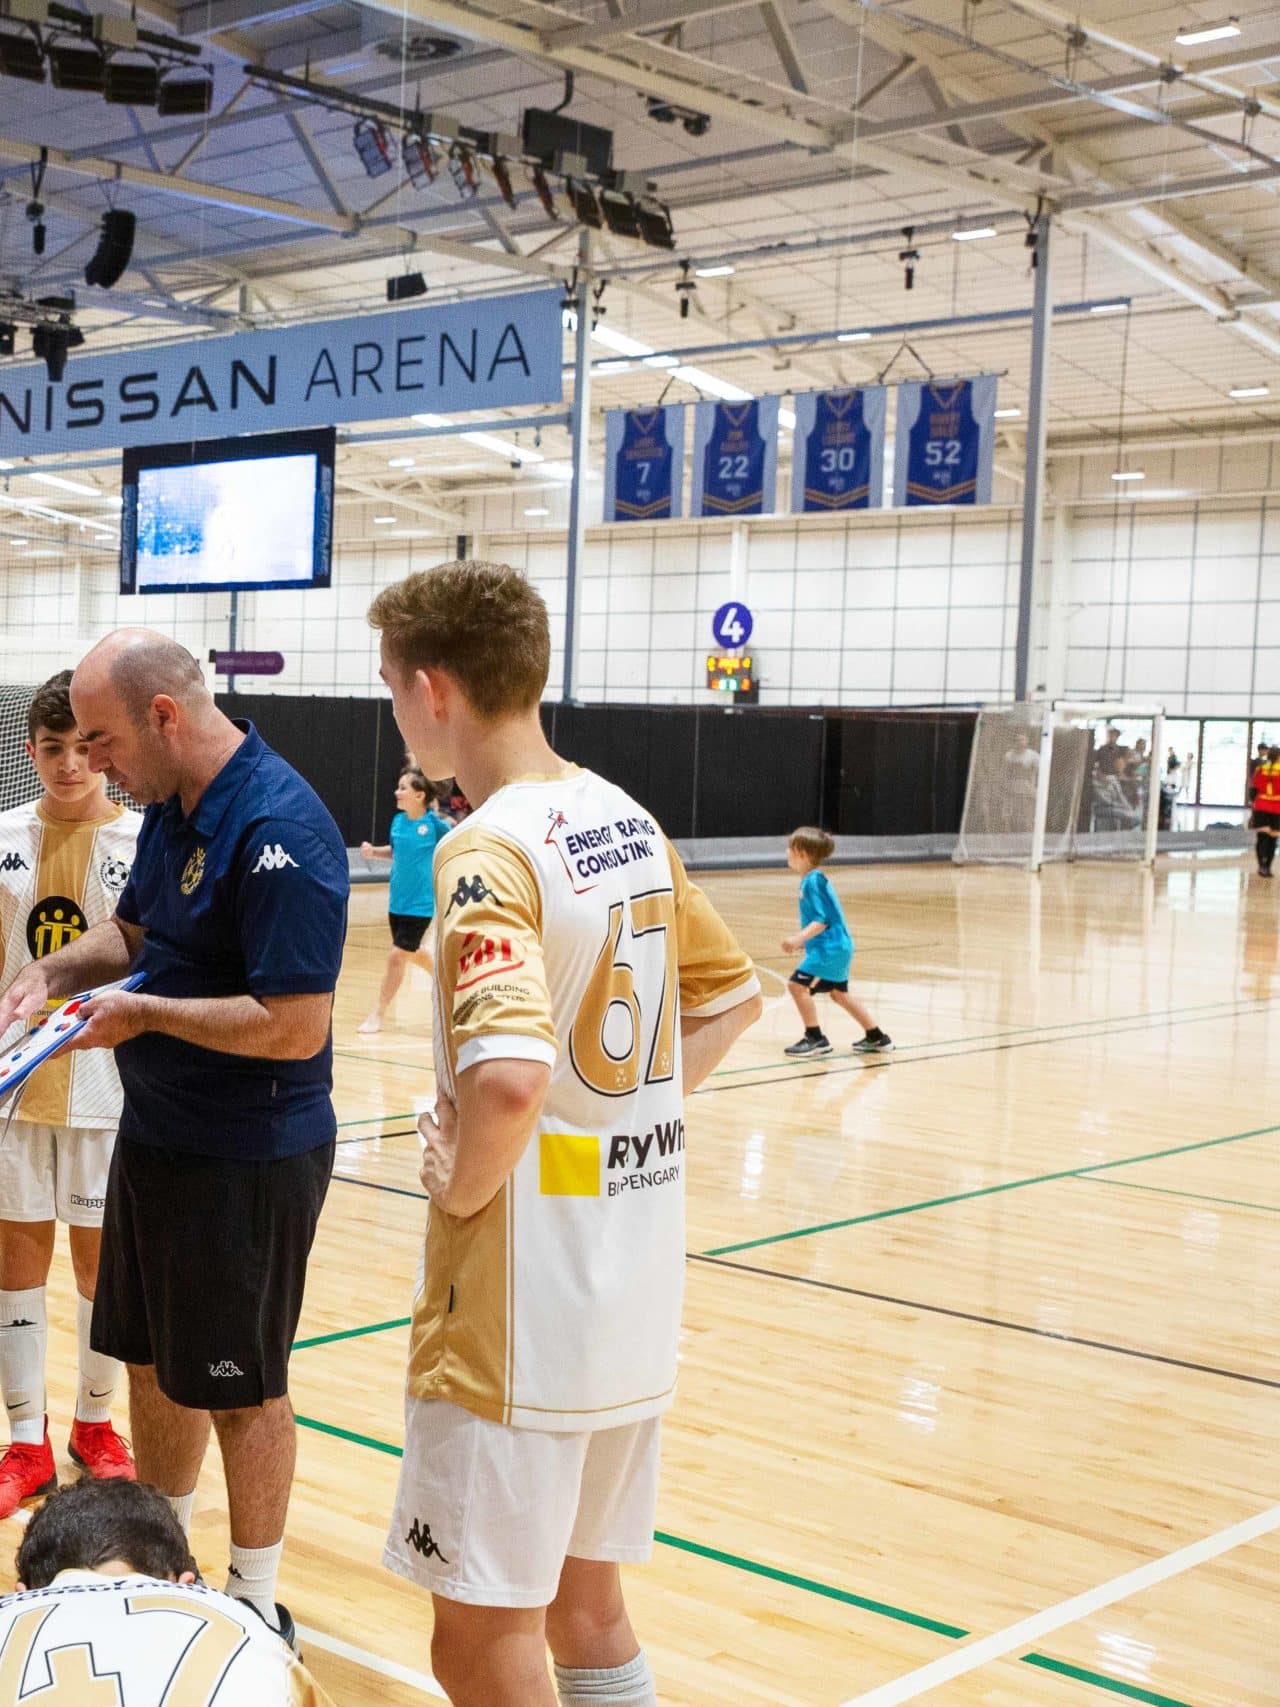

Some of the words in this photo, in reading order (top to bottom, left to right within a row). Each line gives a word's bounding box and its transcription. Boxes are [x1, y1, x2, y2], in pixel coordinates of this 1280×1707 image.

[305, 322, 531, 401] ARENA
[820, 447, 856, 473] 30
[924, 439, 962, 466] 52
[636, 462, 651, 485] 7
[718, 455, 750, 479] 22
[720, 607, 744, 643] 4
[569, 888, 680, 1097] 67
[70, 1194, 105, 1208] Kapp
